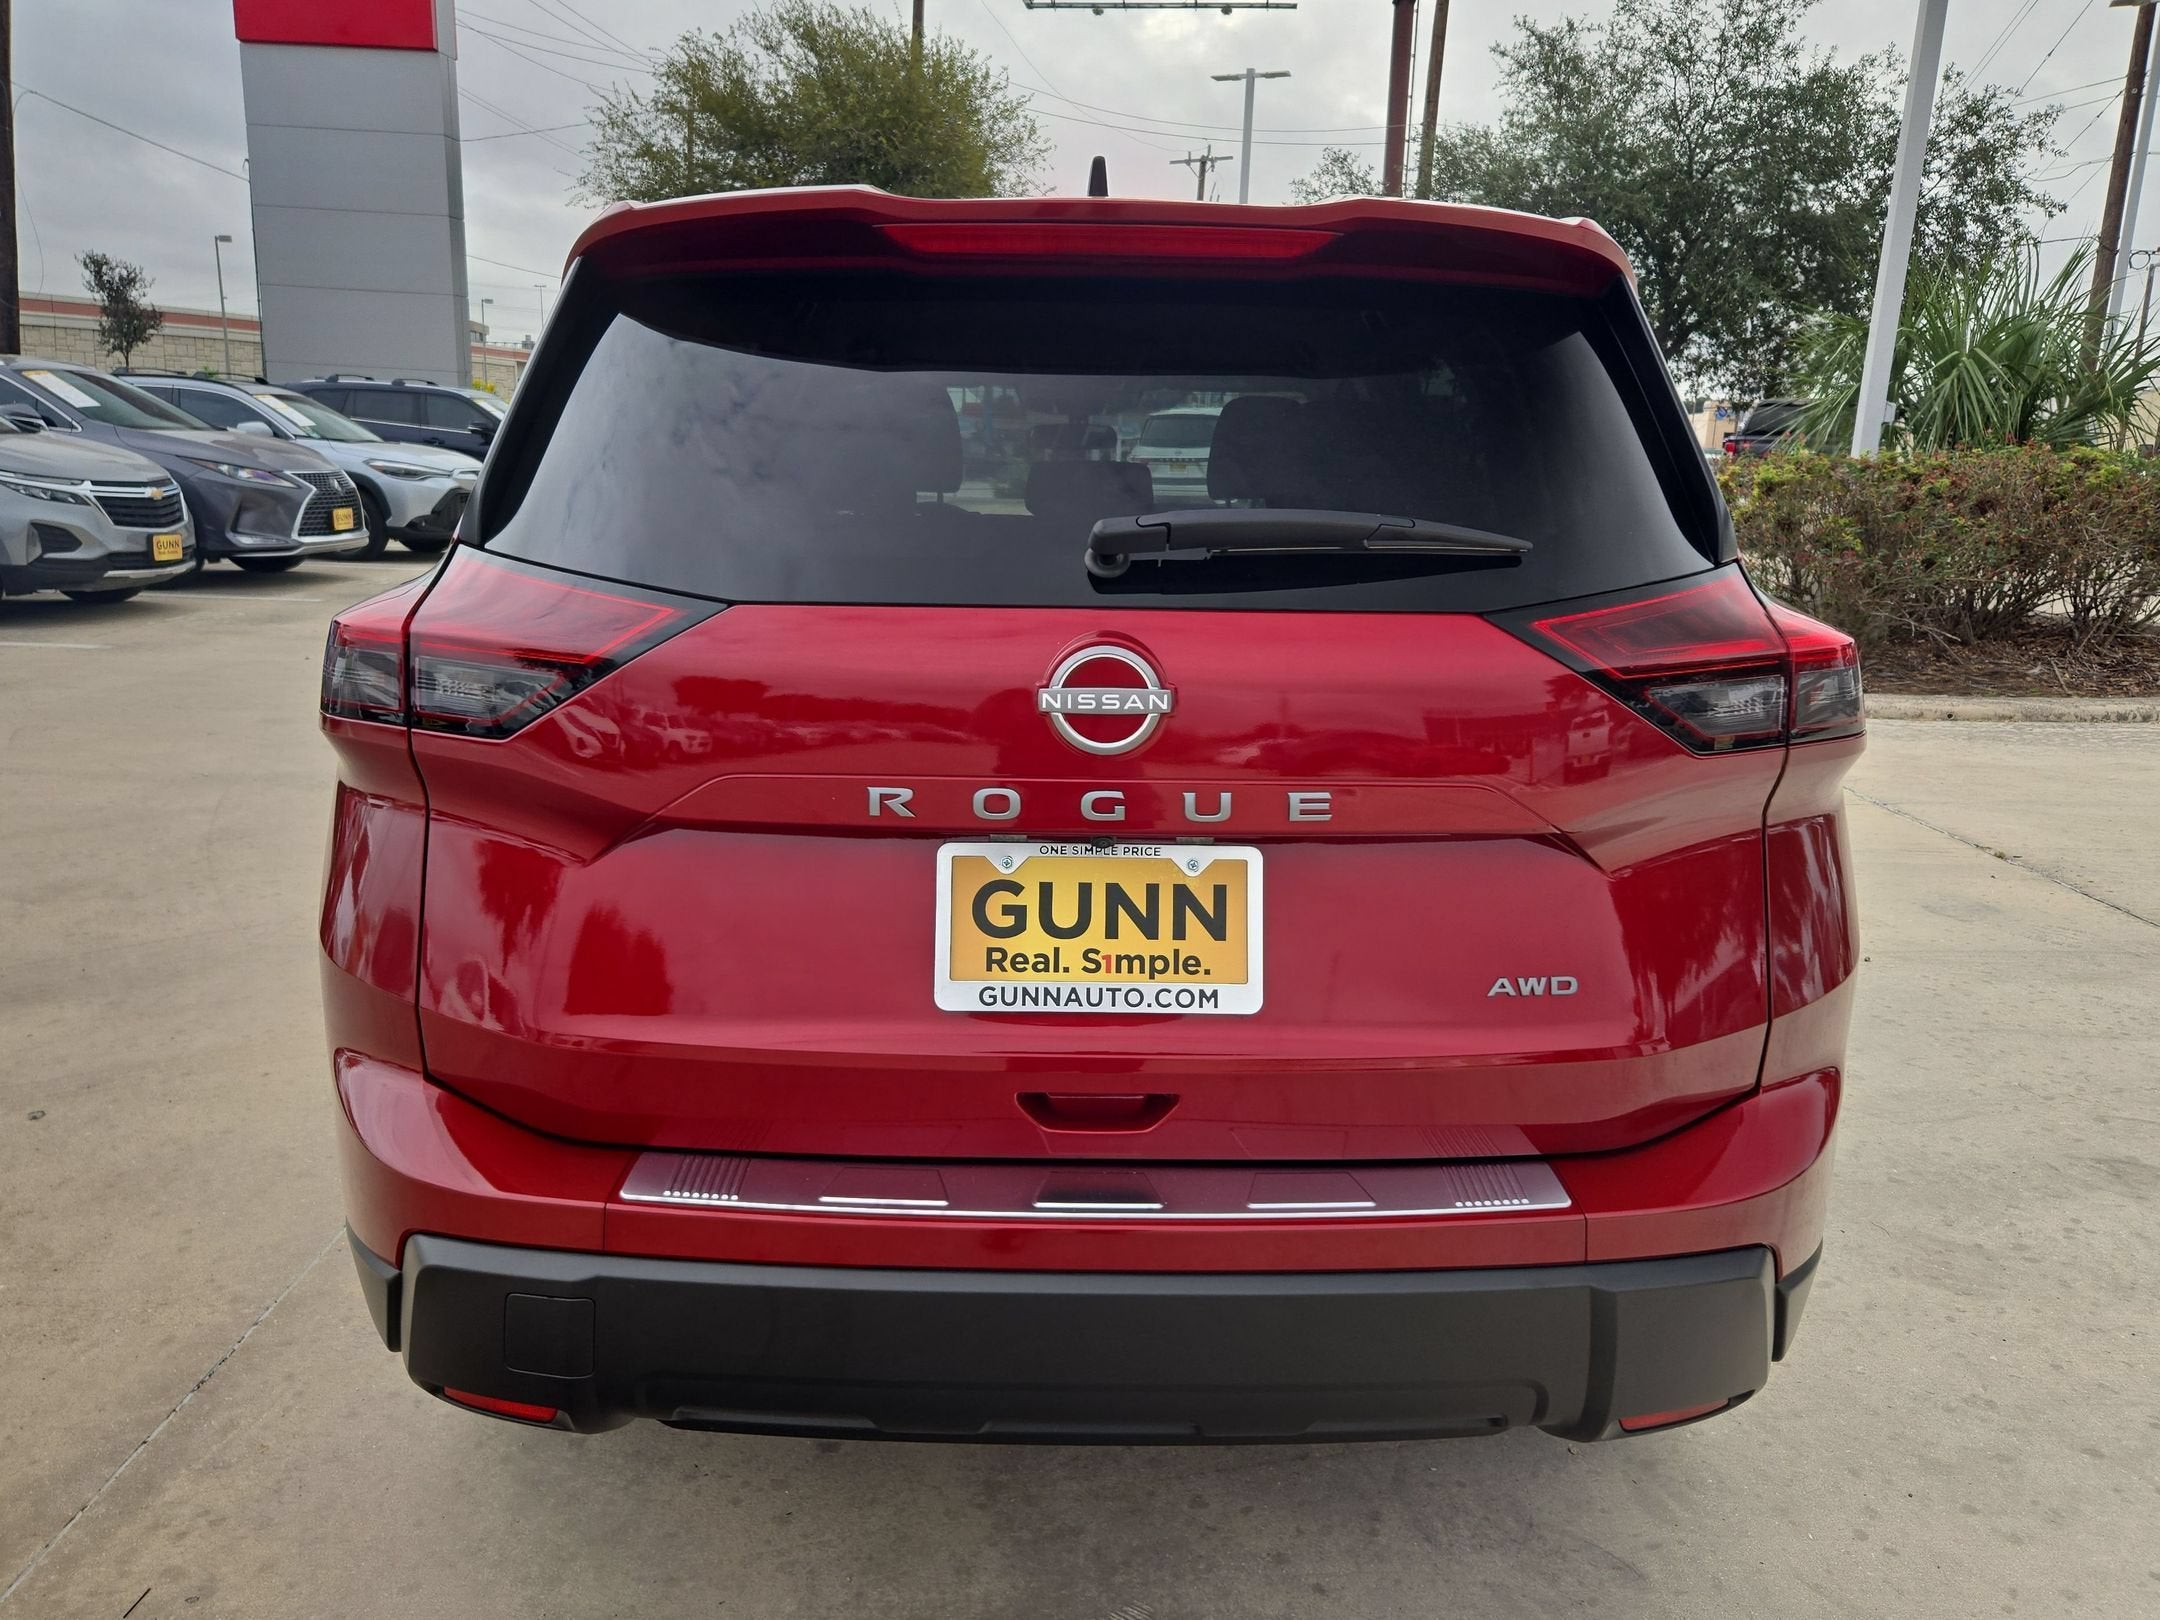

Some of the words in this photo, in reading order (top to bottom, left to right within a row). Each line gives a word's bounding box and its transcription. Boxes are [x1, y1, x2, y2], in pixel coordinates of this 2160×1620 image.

[156, 540, 180, 550] GUNN
[1042, 693, 1168, 710] NISSAN
[867, 786, 1334, 823] ROGUE
[1039, 845, 1068, 855] ONE
[1072, 845, 1119, 856] SIMPLE
[1123, 846, 1161, 857] PRICE
[972, 879, 1228, 942] GUNN
[985, 946, 1070, 974] Real.
[978, 986, 1219, 1009] GUNNAUTO.COM
[1487, 976, 1579, 997] AWD
